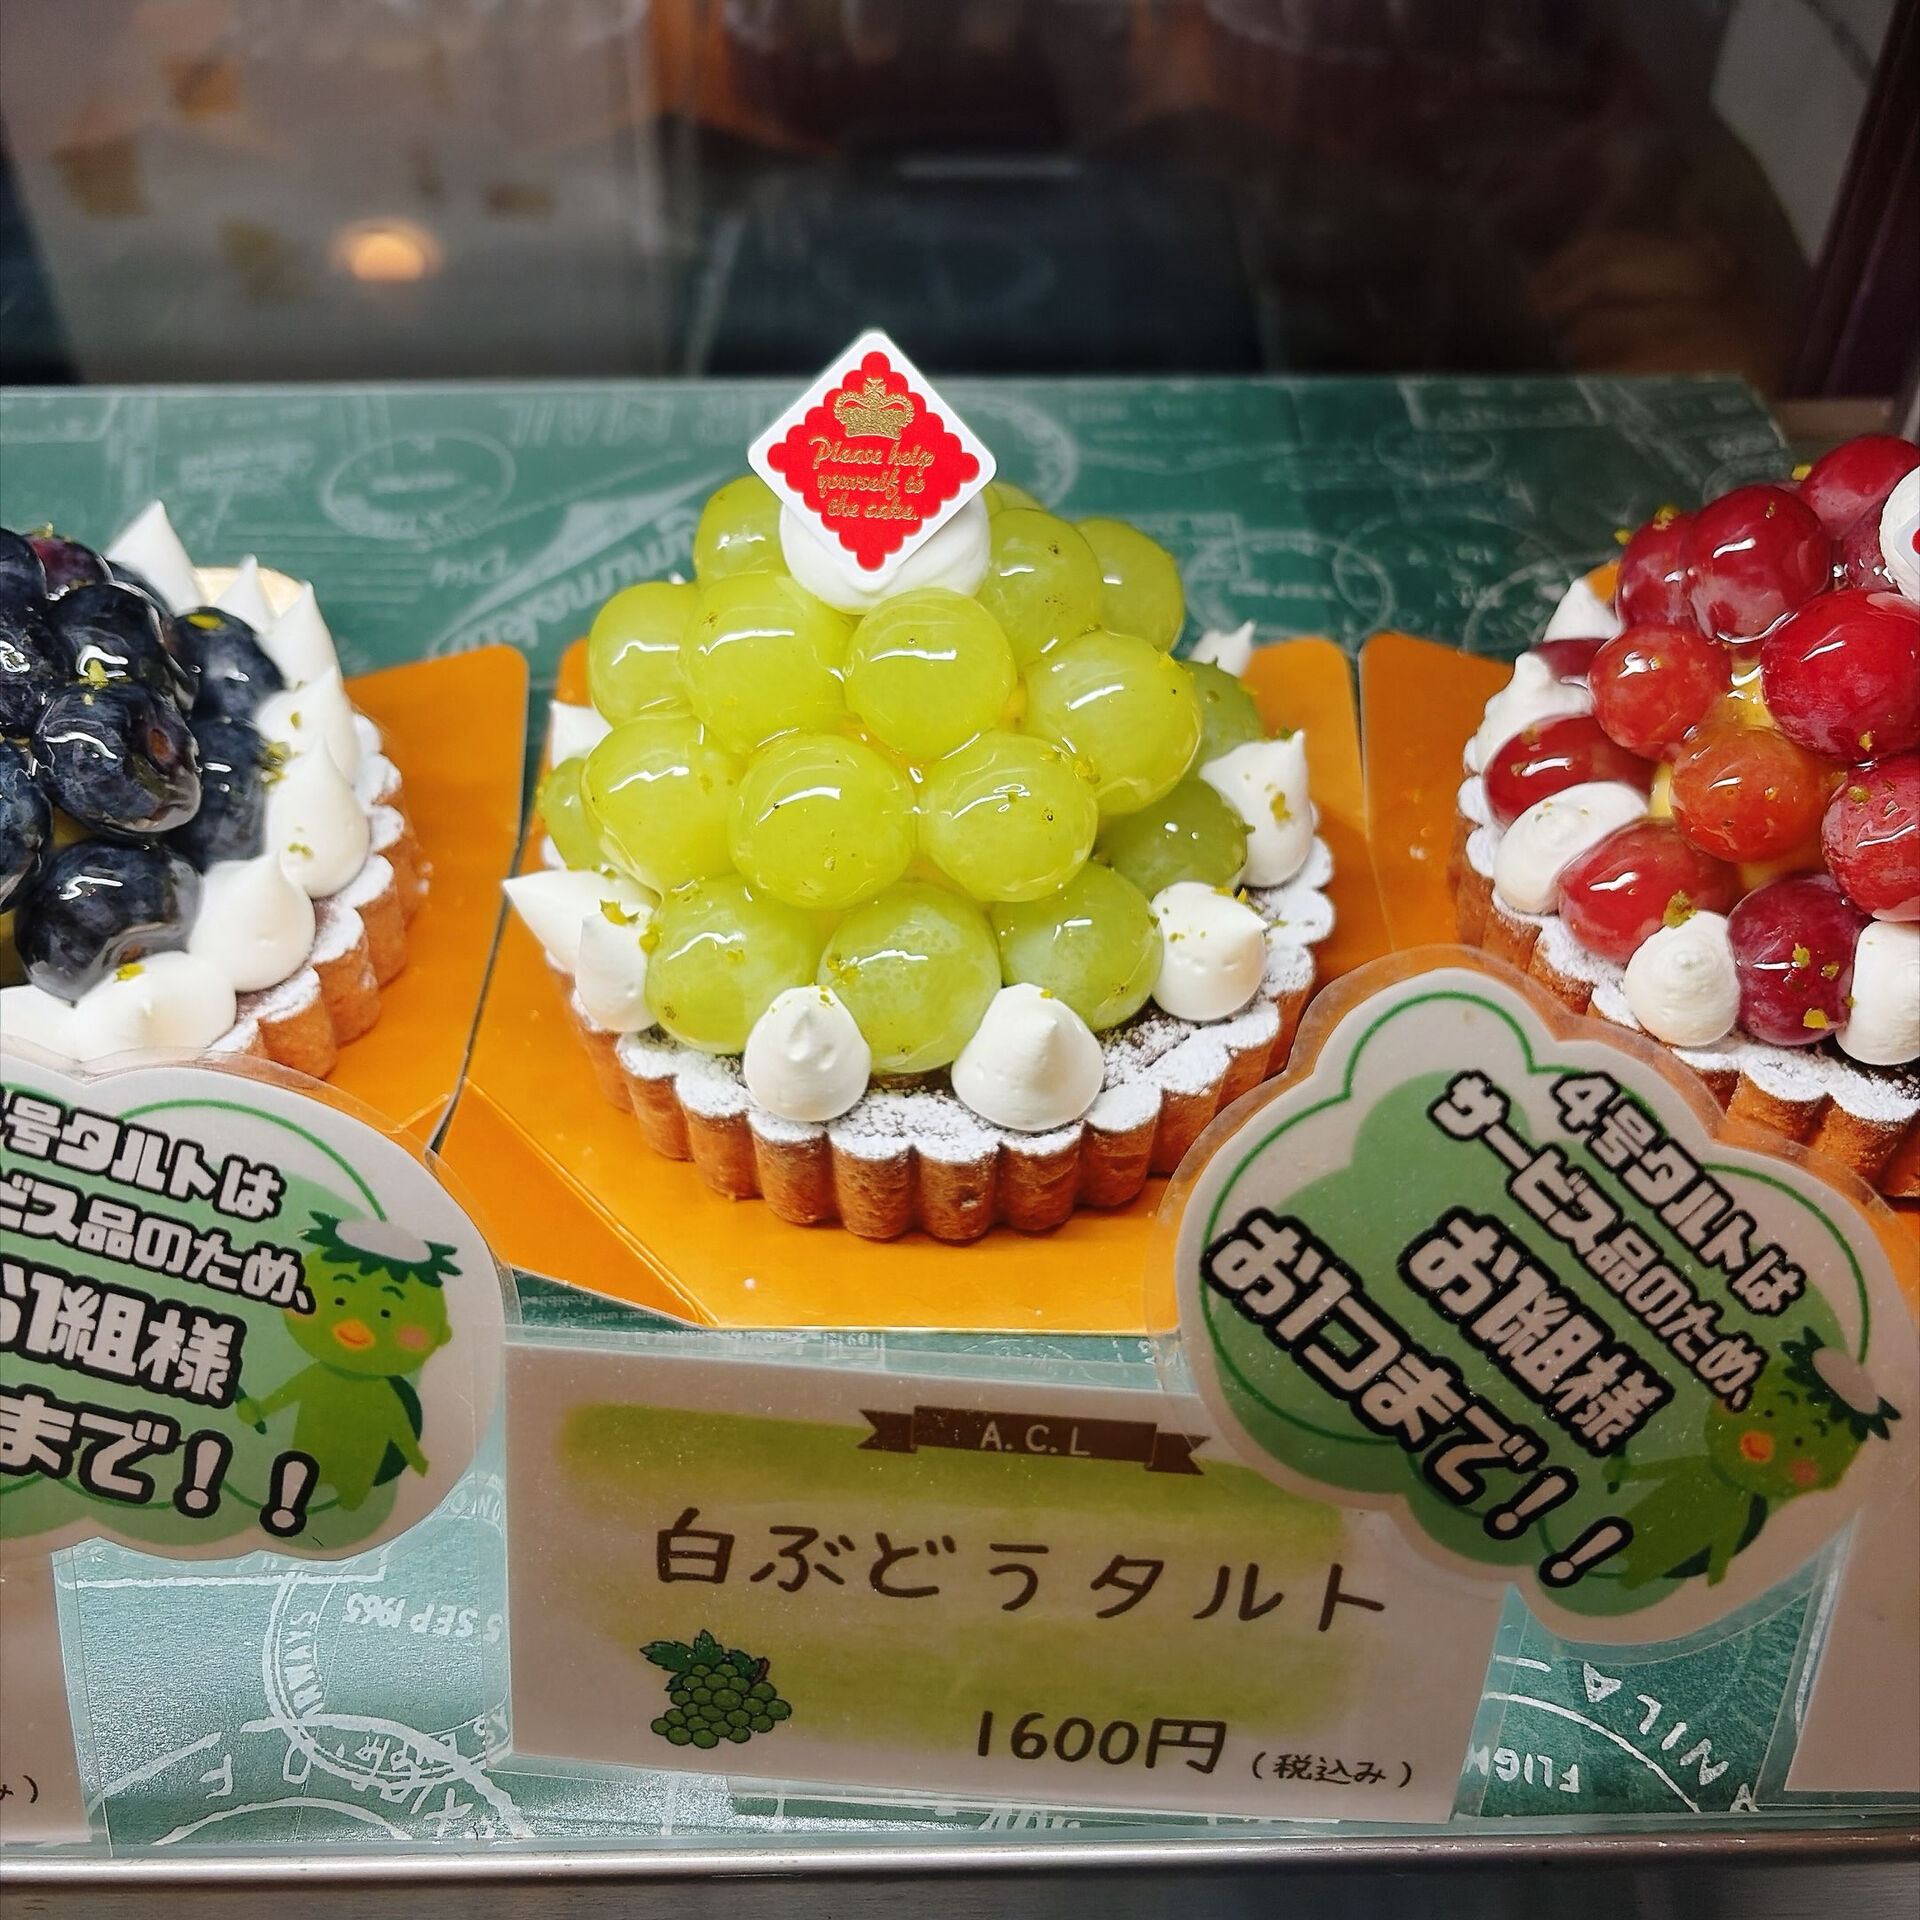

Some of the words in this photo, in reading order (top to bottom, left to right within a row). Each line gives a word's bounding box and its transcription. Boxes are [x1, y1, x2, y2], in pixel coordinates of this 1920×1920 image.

[807, 436, 883, 471] Please
[888, 438, 936, 477] help
[817, 468, 900, 501] yourself
[827, 492, 860, 519] the
[1549, 1071, 1806, 1318] 4号タルトは
[1427, 1070, 1770, 1412] サービス品のため、
[0, 1256, 248, 1409] 1組様
[1401, 1207, 1675, 1457] お1組様
[654, 1507, 1387, 1633] 白ぶどうタルト
[342, 1592, 402, 1631] 1965
[410, 1601, 480, 1640] SEP
[976, 1710, 1227, 1775] 1600円
